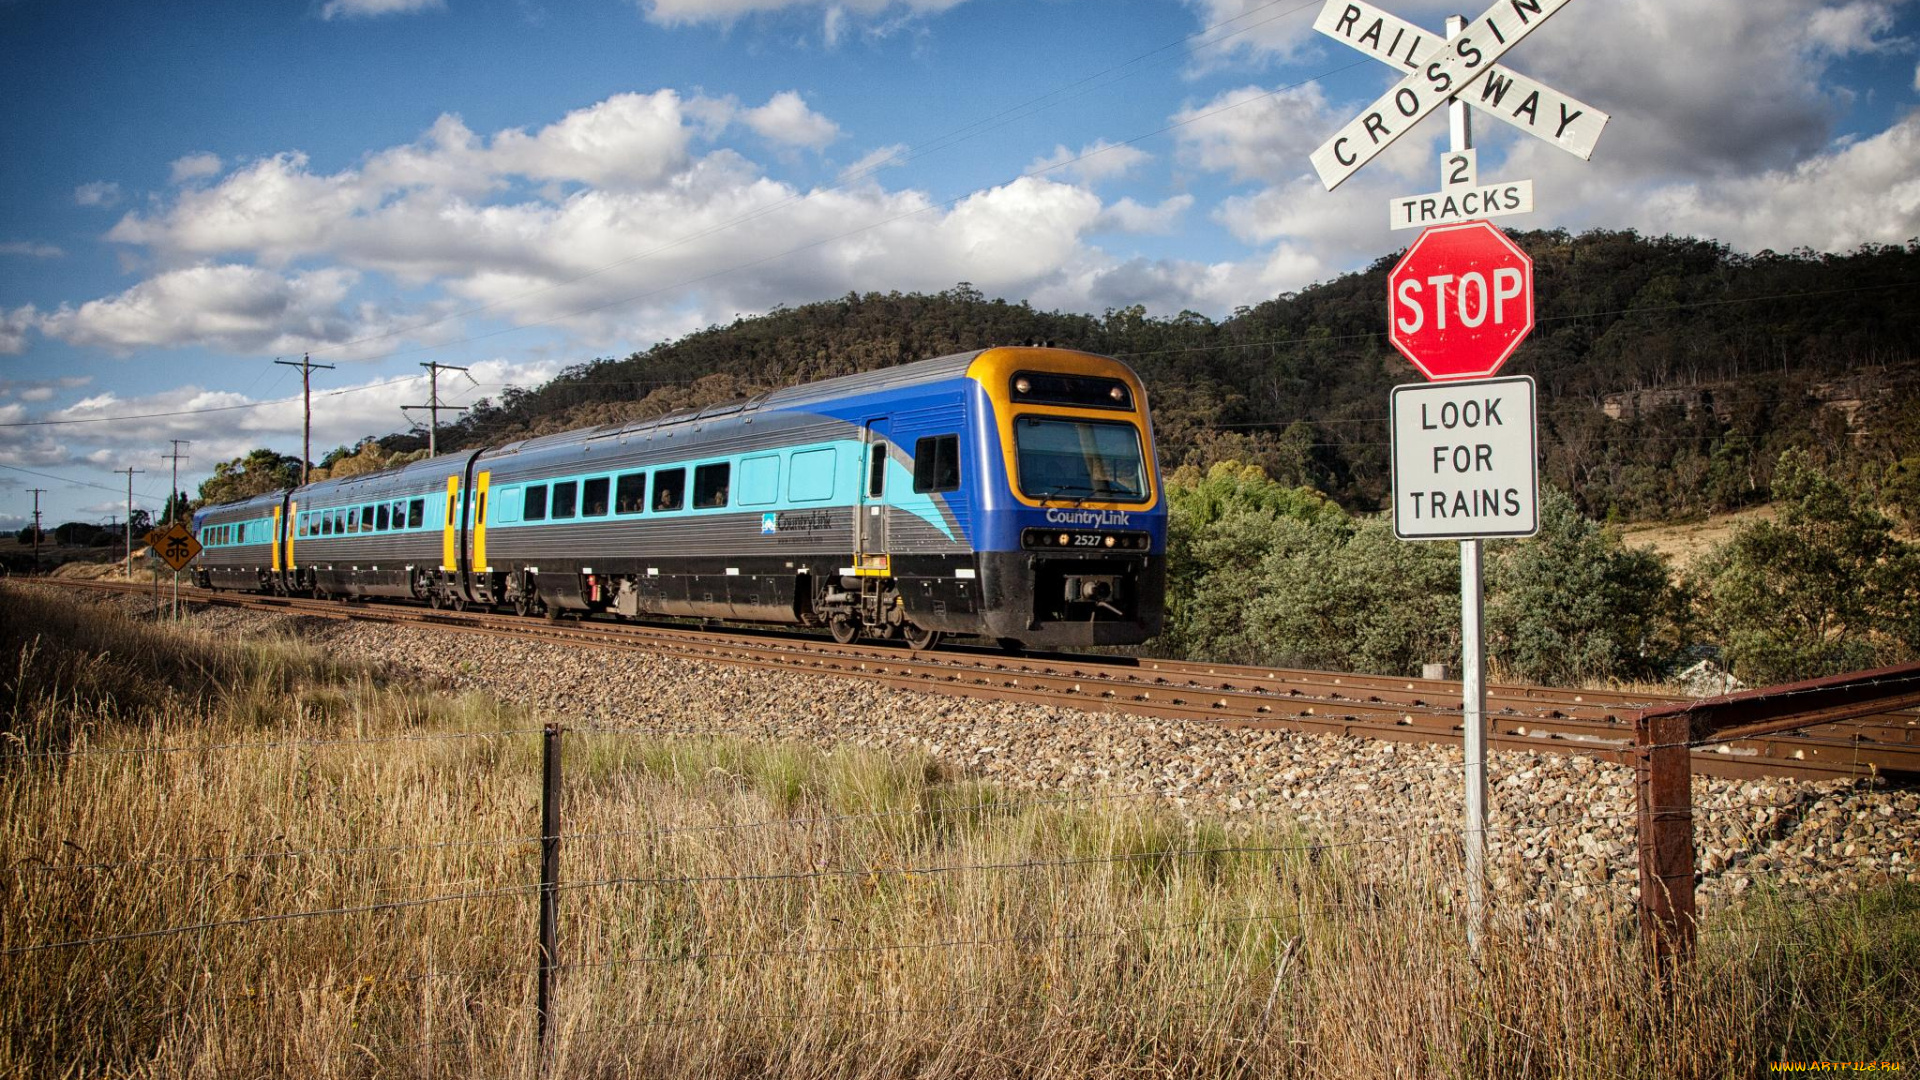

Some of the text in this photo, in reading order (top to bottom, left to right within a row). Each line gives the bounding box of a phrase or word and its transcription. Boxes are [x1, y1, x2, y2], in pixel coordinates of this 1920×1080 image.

[1449, 156, 1469, 185] 2
[1402, 186, 1520, 223] TRACKS
[1397, 267, 1523, 334] STOP
[1421, 397, 1503, 430] LOOK
[1433, 443, 1493, 474] FOR
[1046, 507, 1130, 529] CountryLink
[1410, 488, 1520, 519] TRAINS
[777, 510, 832, 535] CountryLink
[1074, 534, 1101, 546] 2527
